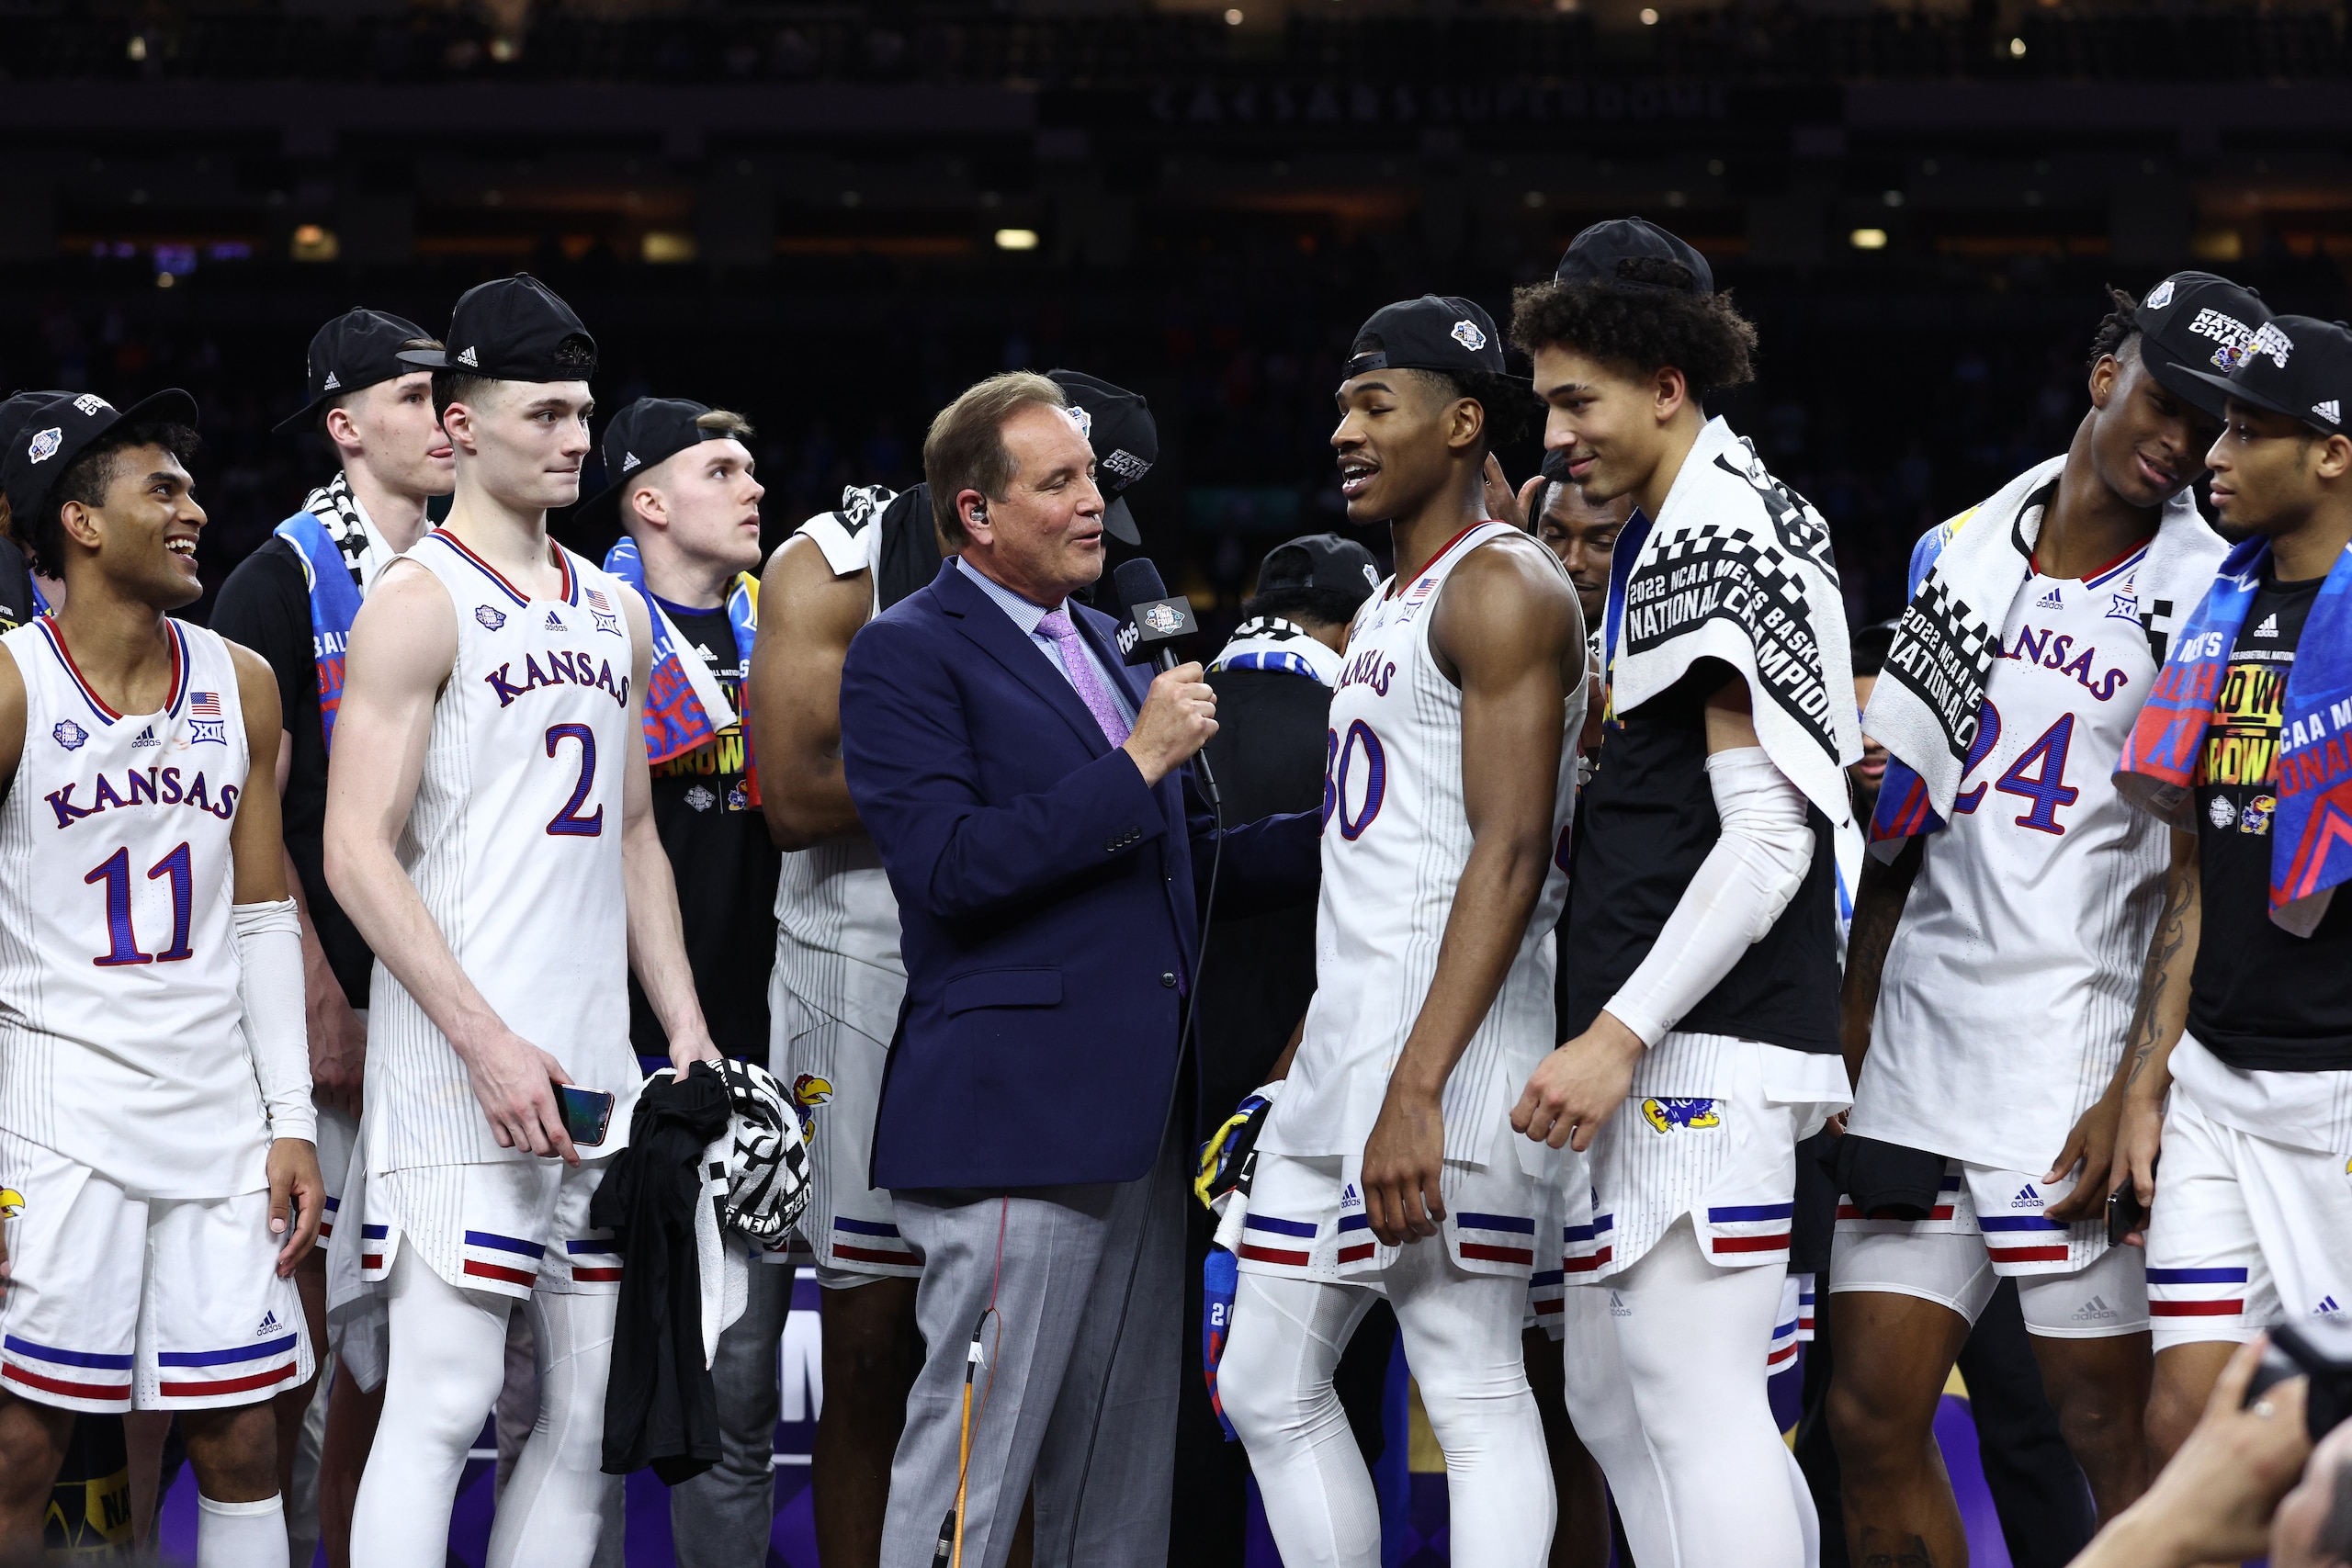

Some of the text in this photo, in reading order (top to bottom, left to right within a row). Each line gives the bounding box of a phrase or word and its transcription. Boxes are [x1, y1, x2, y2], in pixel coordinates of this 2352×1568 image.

[458, 355, 479, 367] adidas
[324, 380, 341, 390] adidas
[2311, 405, 2342, 425] adidas
[1630, 575, 1666, 605] 2022
[1670, 560, 1709, 591] NCAA
[1713, 558, 1770, 610] MEN'S
[1629, 581, 1723, 642] NATIONAL
[2036, 600, 2064, 611] adidas
[1156, 610, 1173, 620] FINAL
[544, 624, 568, 632] adidas
[1157, 617, 1174, 627] FOUR
[1116, 621, 1139, 655] tbs
[1901, 604, 1941, 651] 2022
[1938, 640, 1970, 688] NCAA
[484, 650, 629, 708] KANSAS
[62, 727, 78, 736] FINAL
[62, 734, 78, 742] FOUR
[131, 739, 162, 749] adidas
[1954, 695, 2079, 836] 24
[544, 723, 604, 835] 2
[44, 766, 239, 829] KANSAS
[85, 841, 194, 966] 11
[2011, 1198, 2044, 1209] adidas
[2071, 1310, 2118, 1321] adidas
[256, 1323, 283, 1337] adidas
